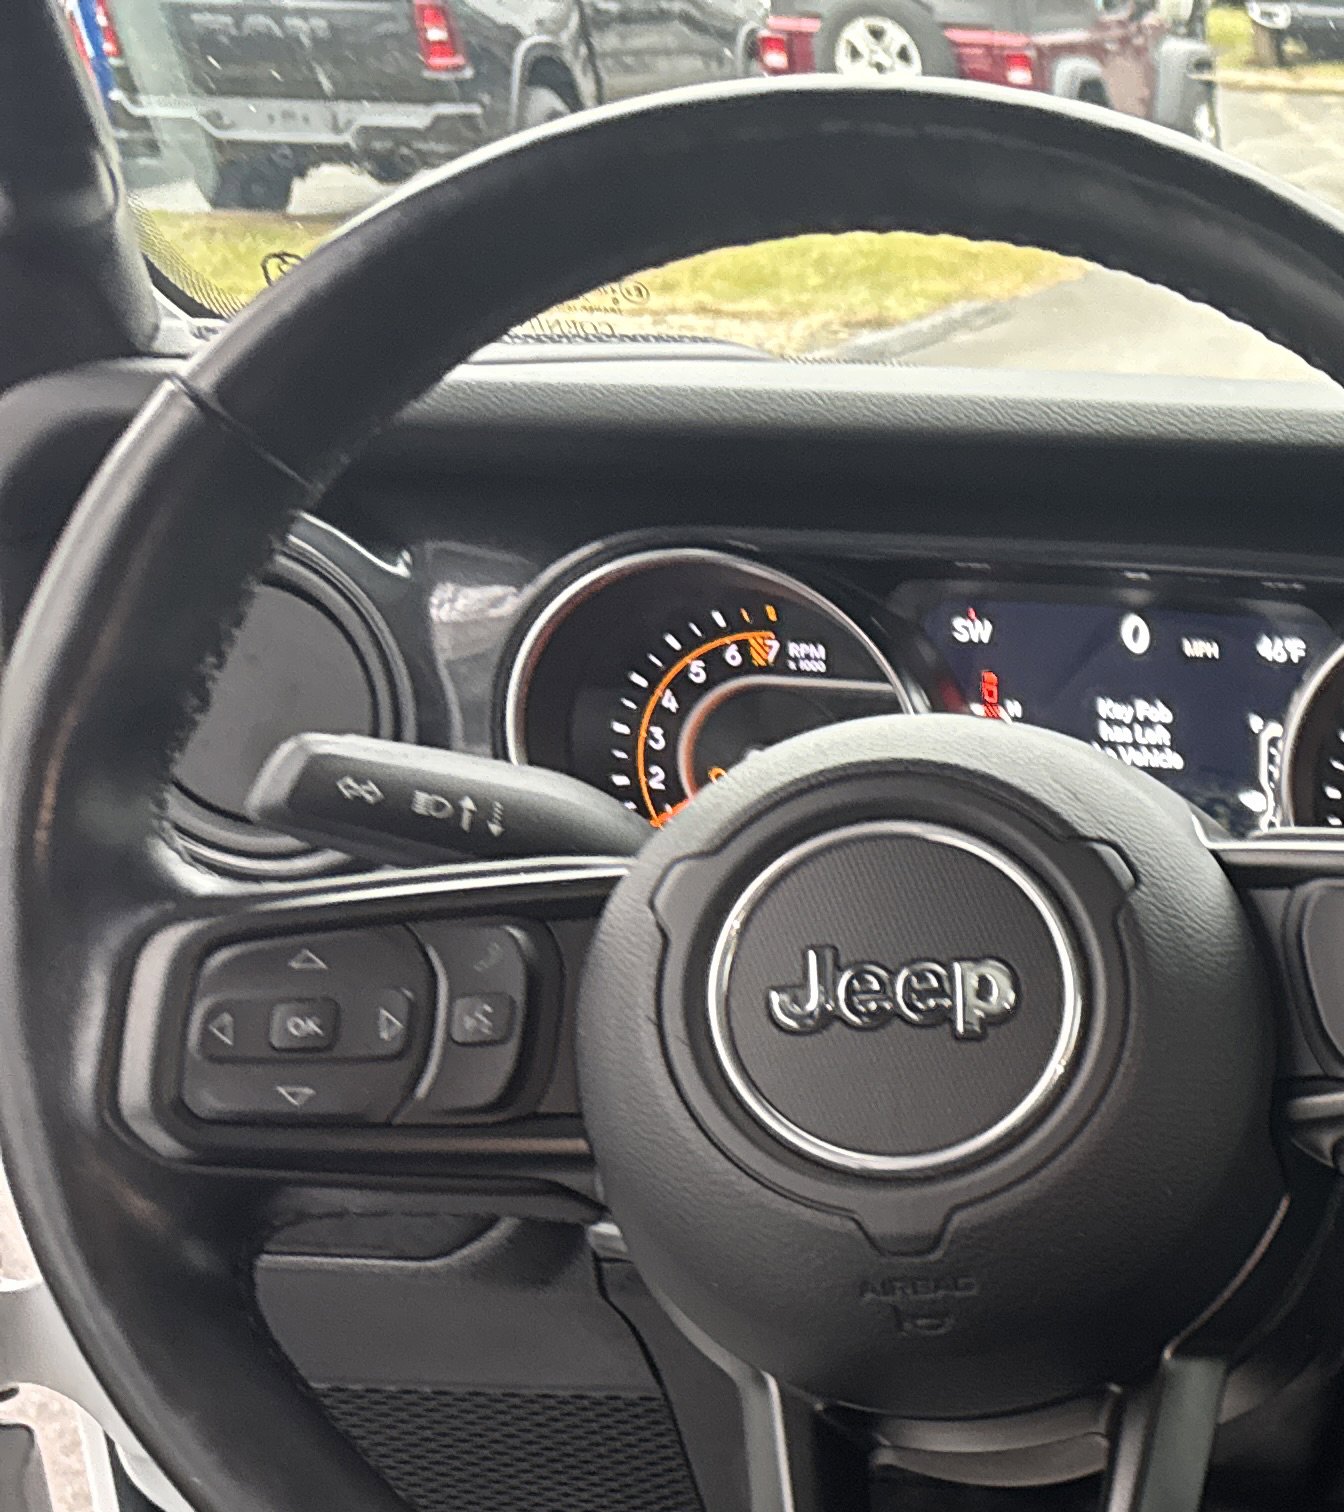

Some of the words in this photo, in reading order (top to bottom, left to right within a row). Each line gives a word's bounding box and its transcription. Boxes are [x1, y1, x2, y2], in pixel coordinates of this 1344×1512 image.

[952, 617, 993, 643] SW
[1120, 612, 1150, 654] 0
[1181, 636, 1220, 660] MPH
[724, 643, 742, 667] 6
[765, 639, 780, 665] 7
[788, 641, 826, 660] RPM
[688, 660, 706, 683] 5
[661, 689, 680, 713] 4
[648, 726, 666, 750] 3
[649, 765, 666, 790] 2
[769, 944, 1019, 1040] Jeep
[287, 1015, 323, 1037] OK
